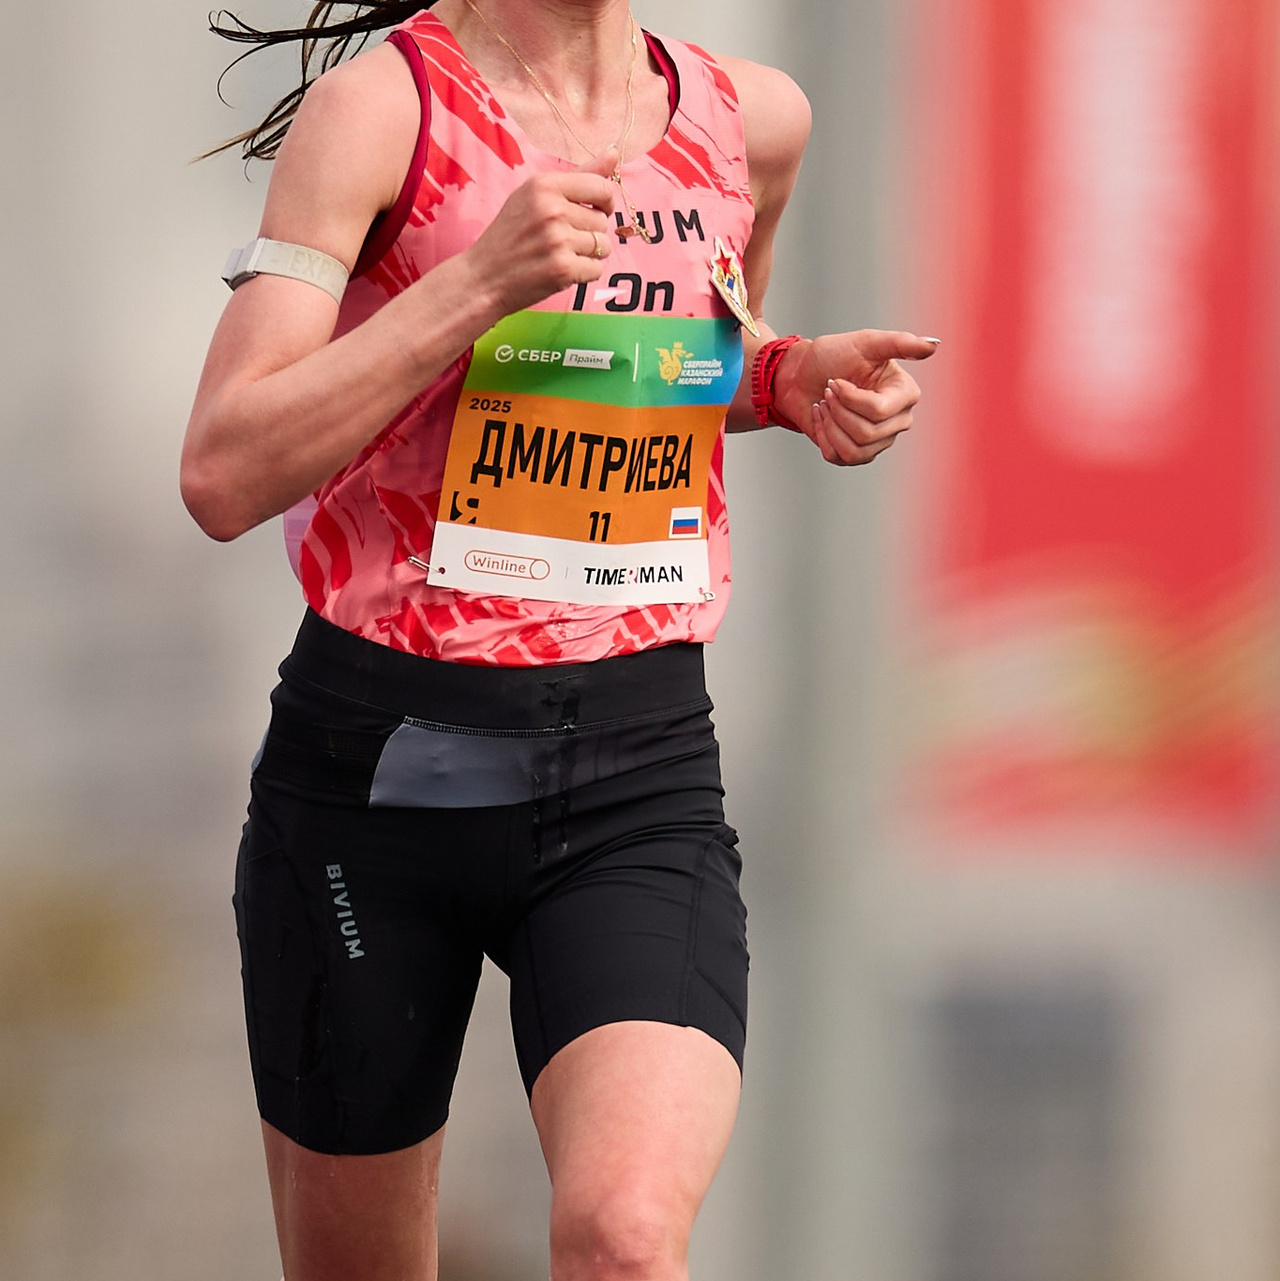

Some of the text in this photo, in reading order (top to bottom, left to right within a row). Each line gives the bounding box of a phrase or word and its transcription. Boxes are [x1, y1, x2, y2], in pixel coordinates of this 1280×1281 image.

[517, 349, 604, 365] СБЕР Прайм
[680, 367, 724, 377] КАЗАНСКИЙ
[677, 377, 713, 386] МАРАФОН
[469, 397, 512, 413] 2025
[469, 419, 694, 493] ДМИТРИЕВА
[588, 510, 612, 543] 11
[472, 555, 526, 574] Winline
[325, 863, 366, 960] BIVIUM
